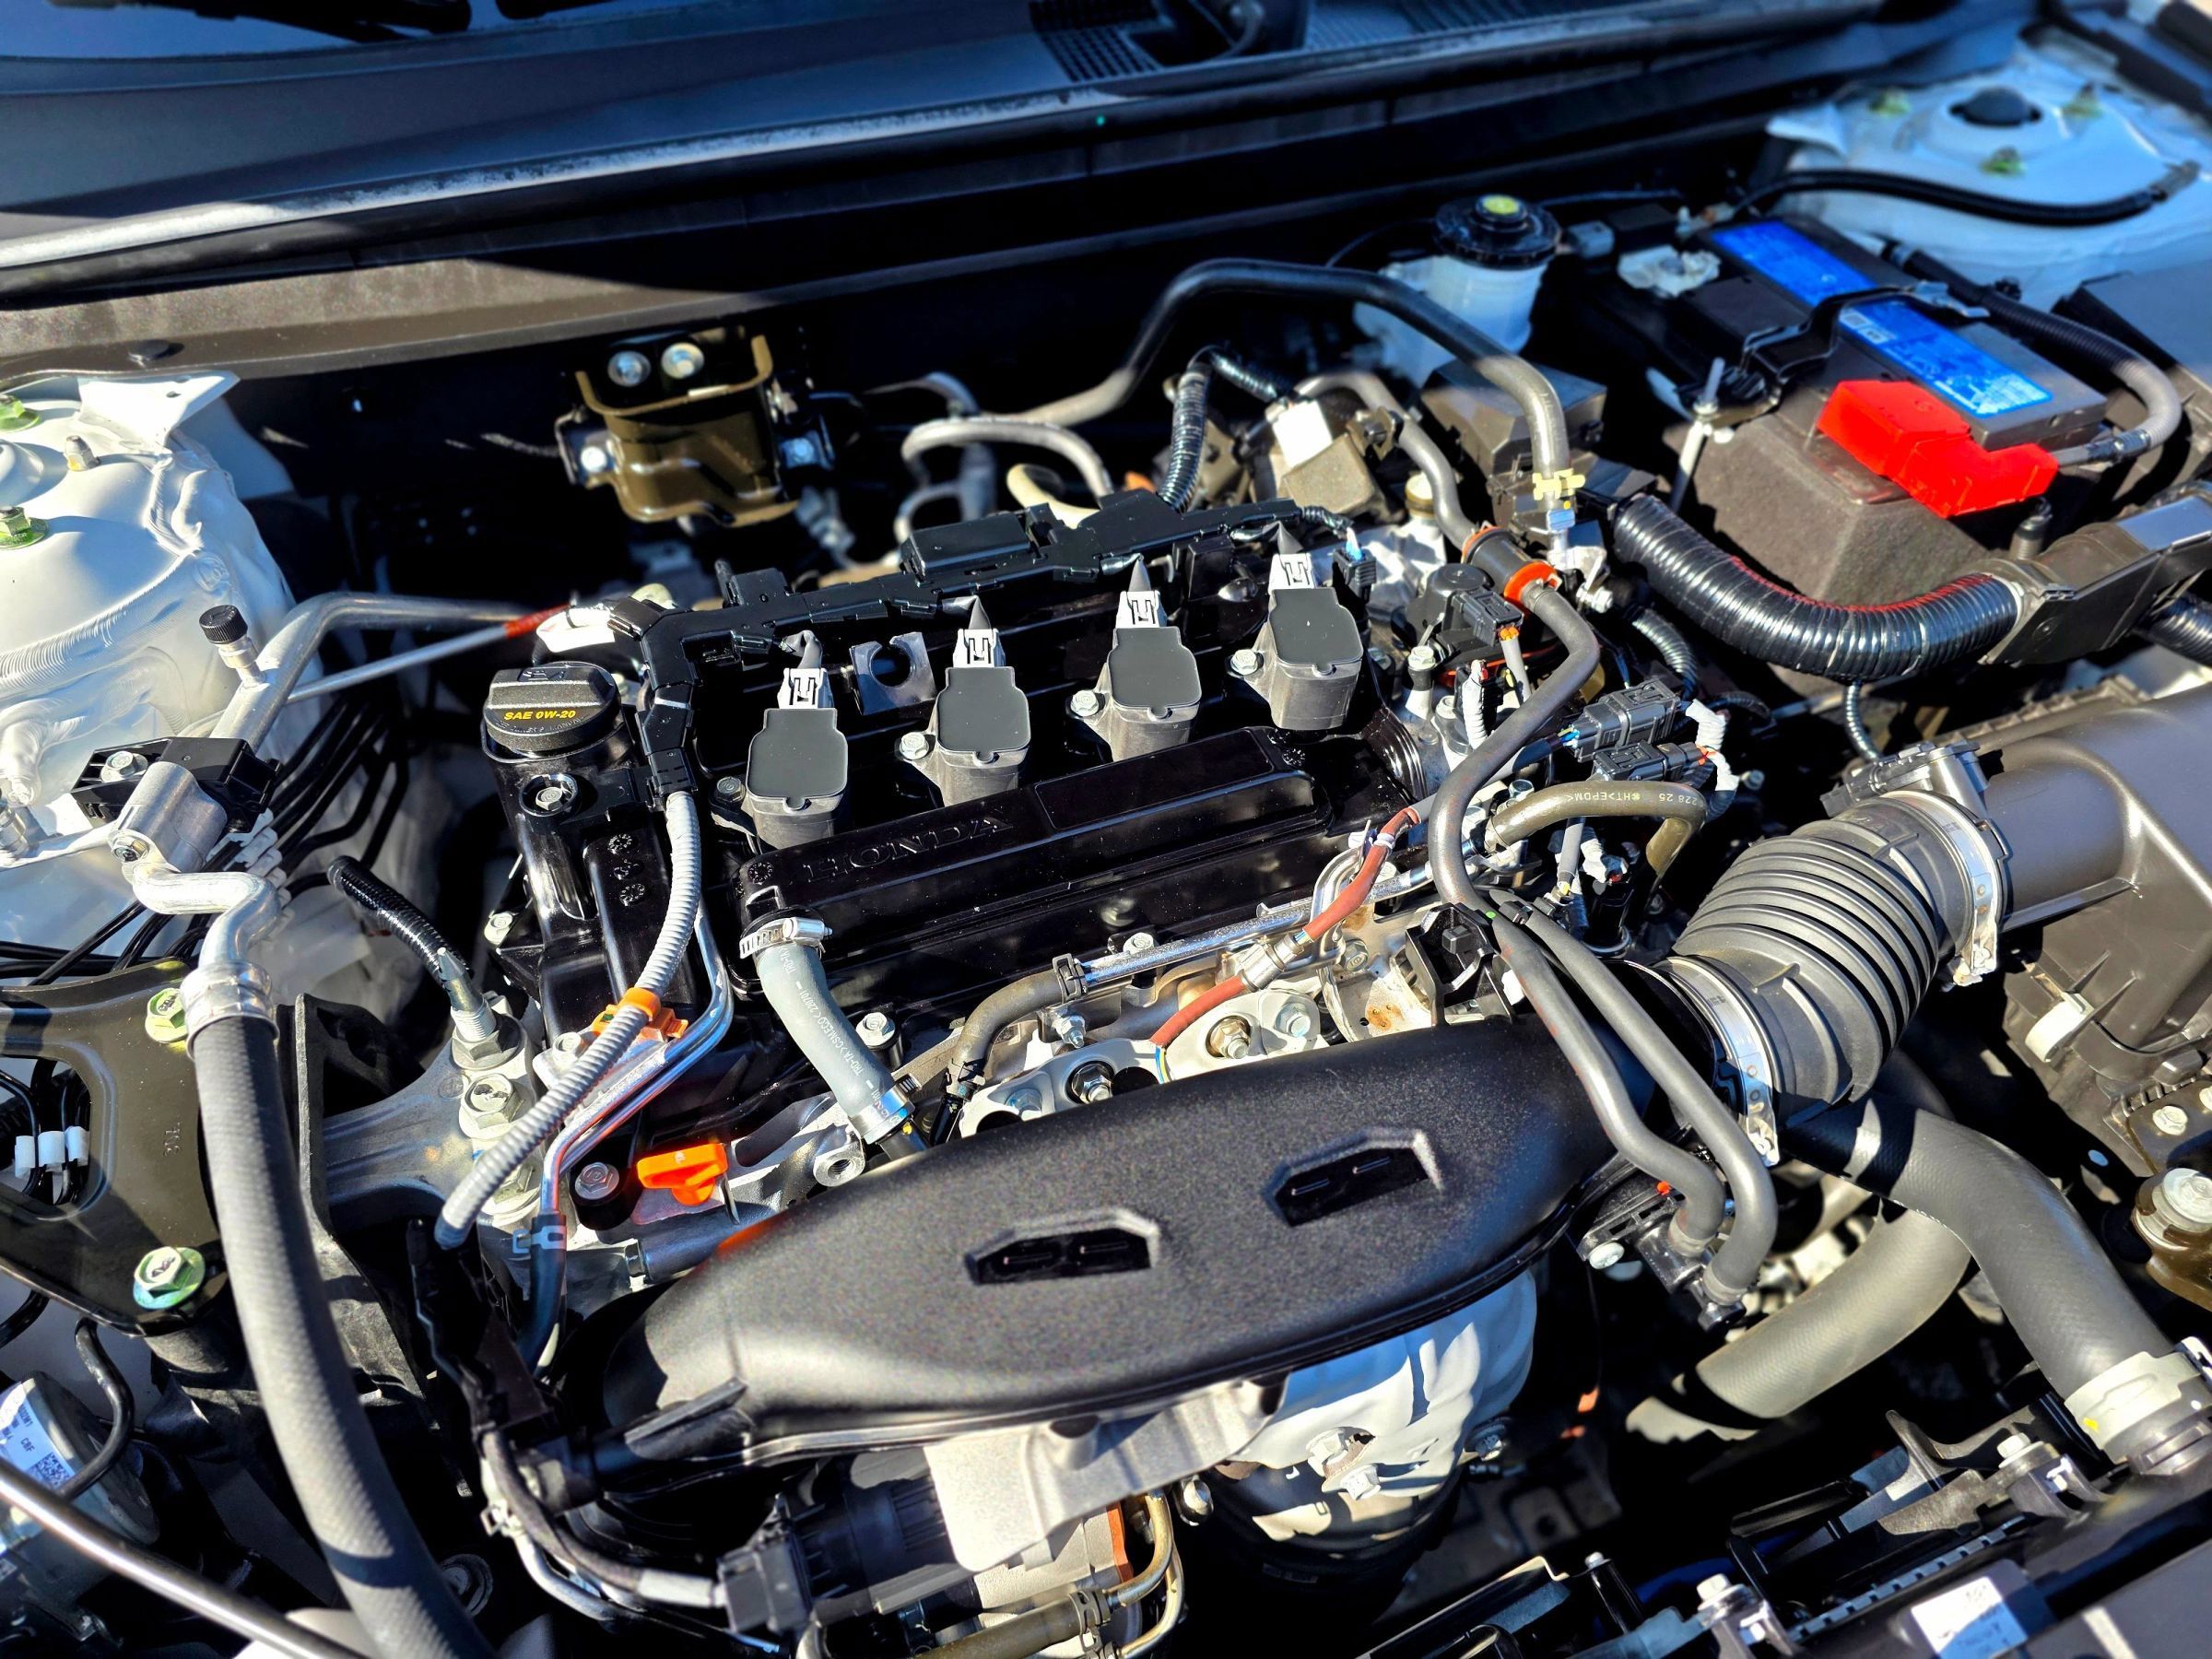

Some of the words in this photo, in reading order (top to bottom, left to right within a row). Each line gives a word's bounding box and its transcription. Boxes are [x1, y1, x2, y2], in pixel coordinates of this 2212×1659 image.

[503, 711, 533, 721] SAE
[535, 710, 576, 720] 0W-20
[1659, 793, 1674, 802] 25
[802, 817, 1014, 883] HONDA
